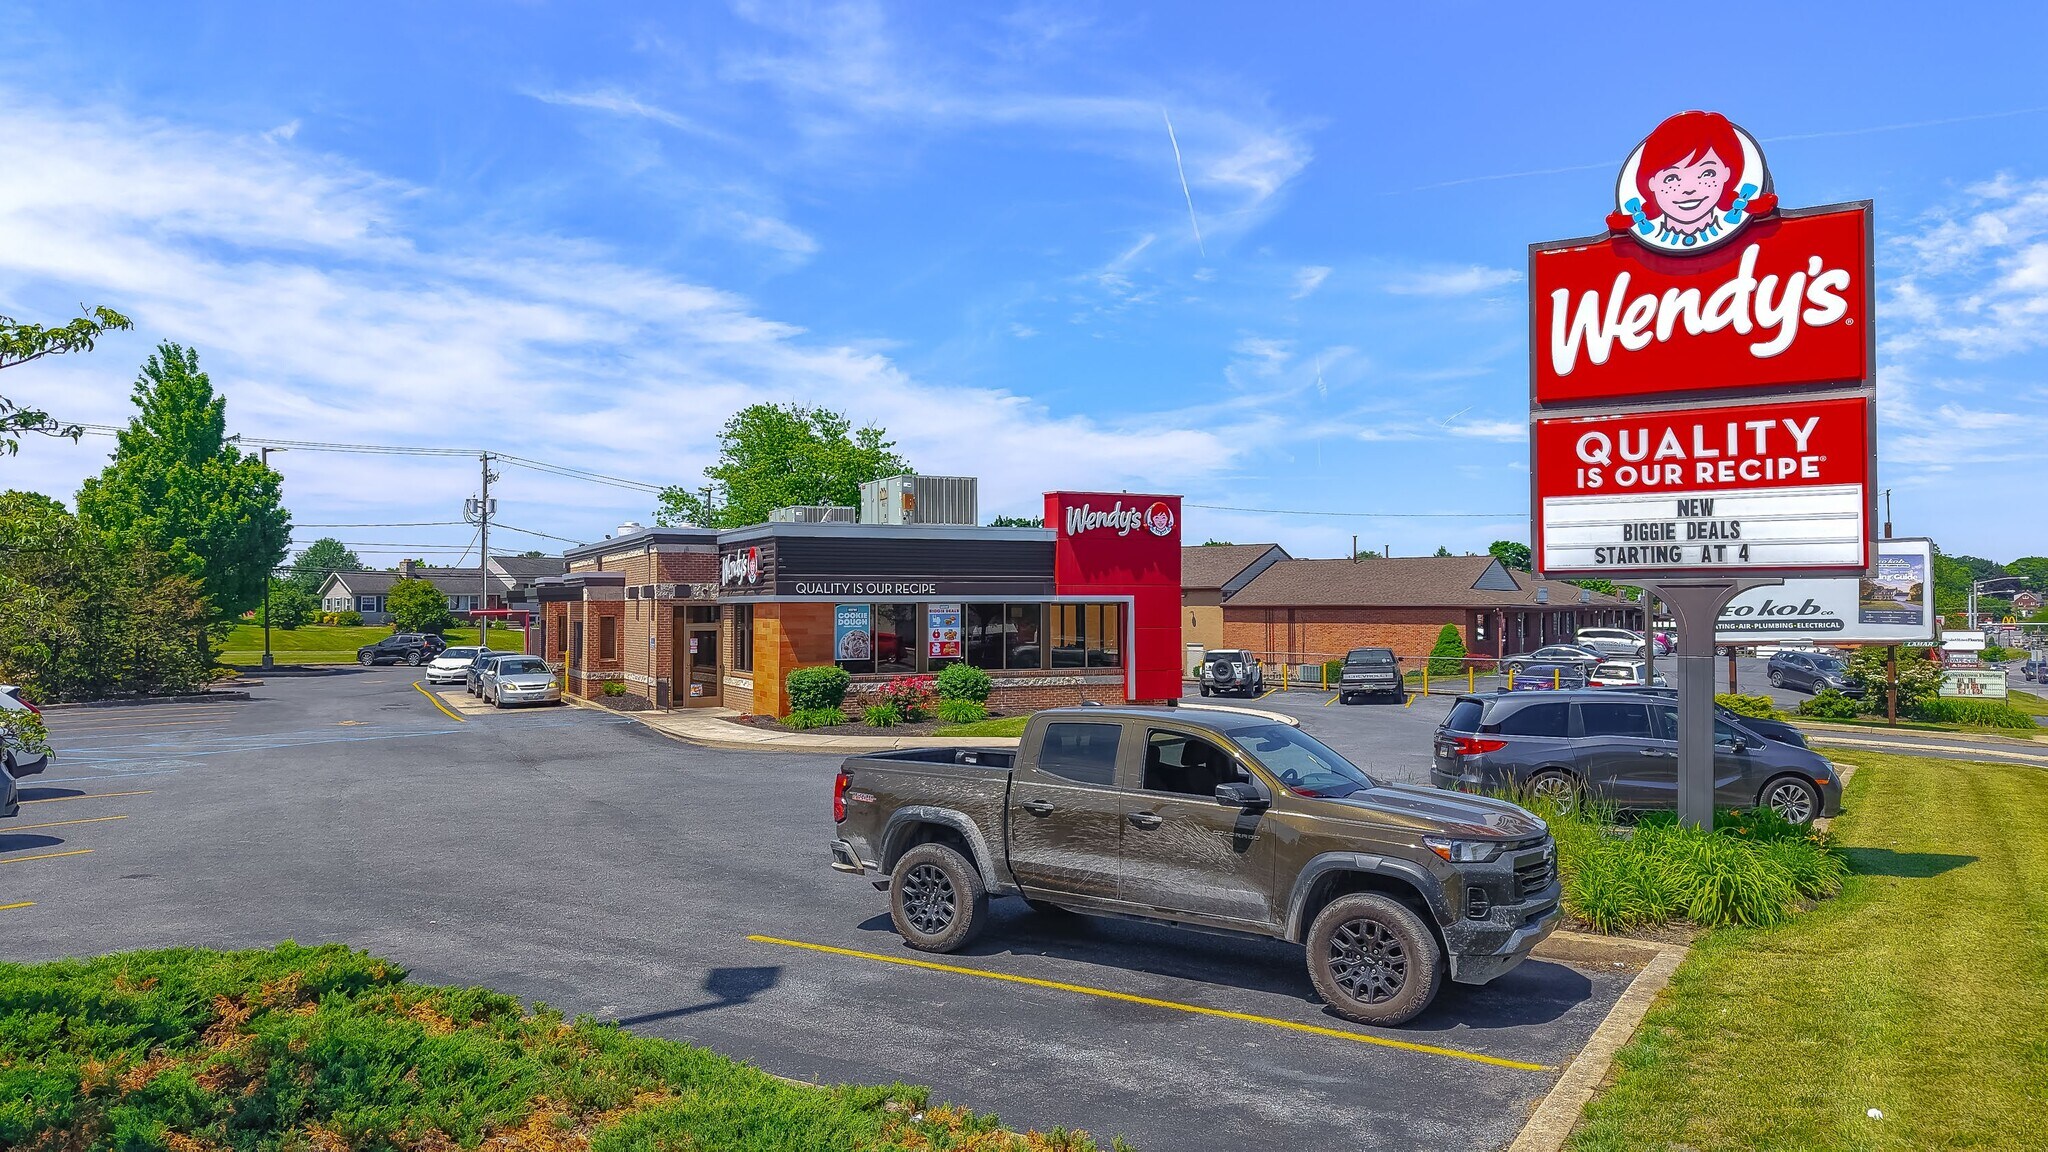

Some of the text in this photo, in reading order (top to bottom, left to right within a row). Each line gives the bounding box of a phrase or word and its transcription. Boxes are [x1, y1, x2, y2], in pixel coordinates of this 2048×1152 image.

[1551, 243, 1850, 376] Wendy's
[1576, 417, 1820, 468] QUALITY
[1577, 467, 1604, 488] IS
[1614, 463, 1684, 487] OUR
[1066, 501, 1141, 536] Wendy's
[1677, 498, 1714, 517] NEW
[1623, 520, 1741, 541] BIGGIE DEALS
[1595, 543, 1749, 564] STARTING AT 4
[721, 549, 747, 586] Wendy's
[795, 582, 936, 594] QUALITY IS OUR RECIPE
[838, 618, 868, 626] DOUGH
